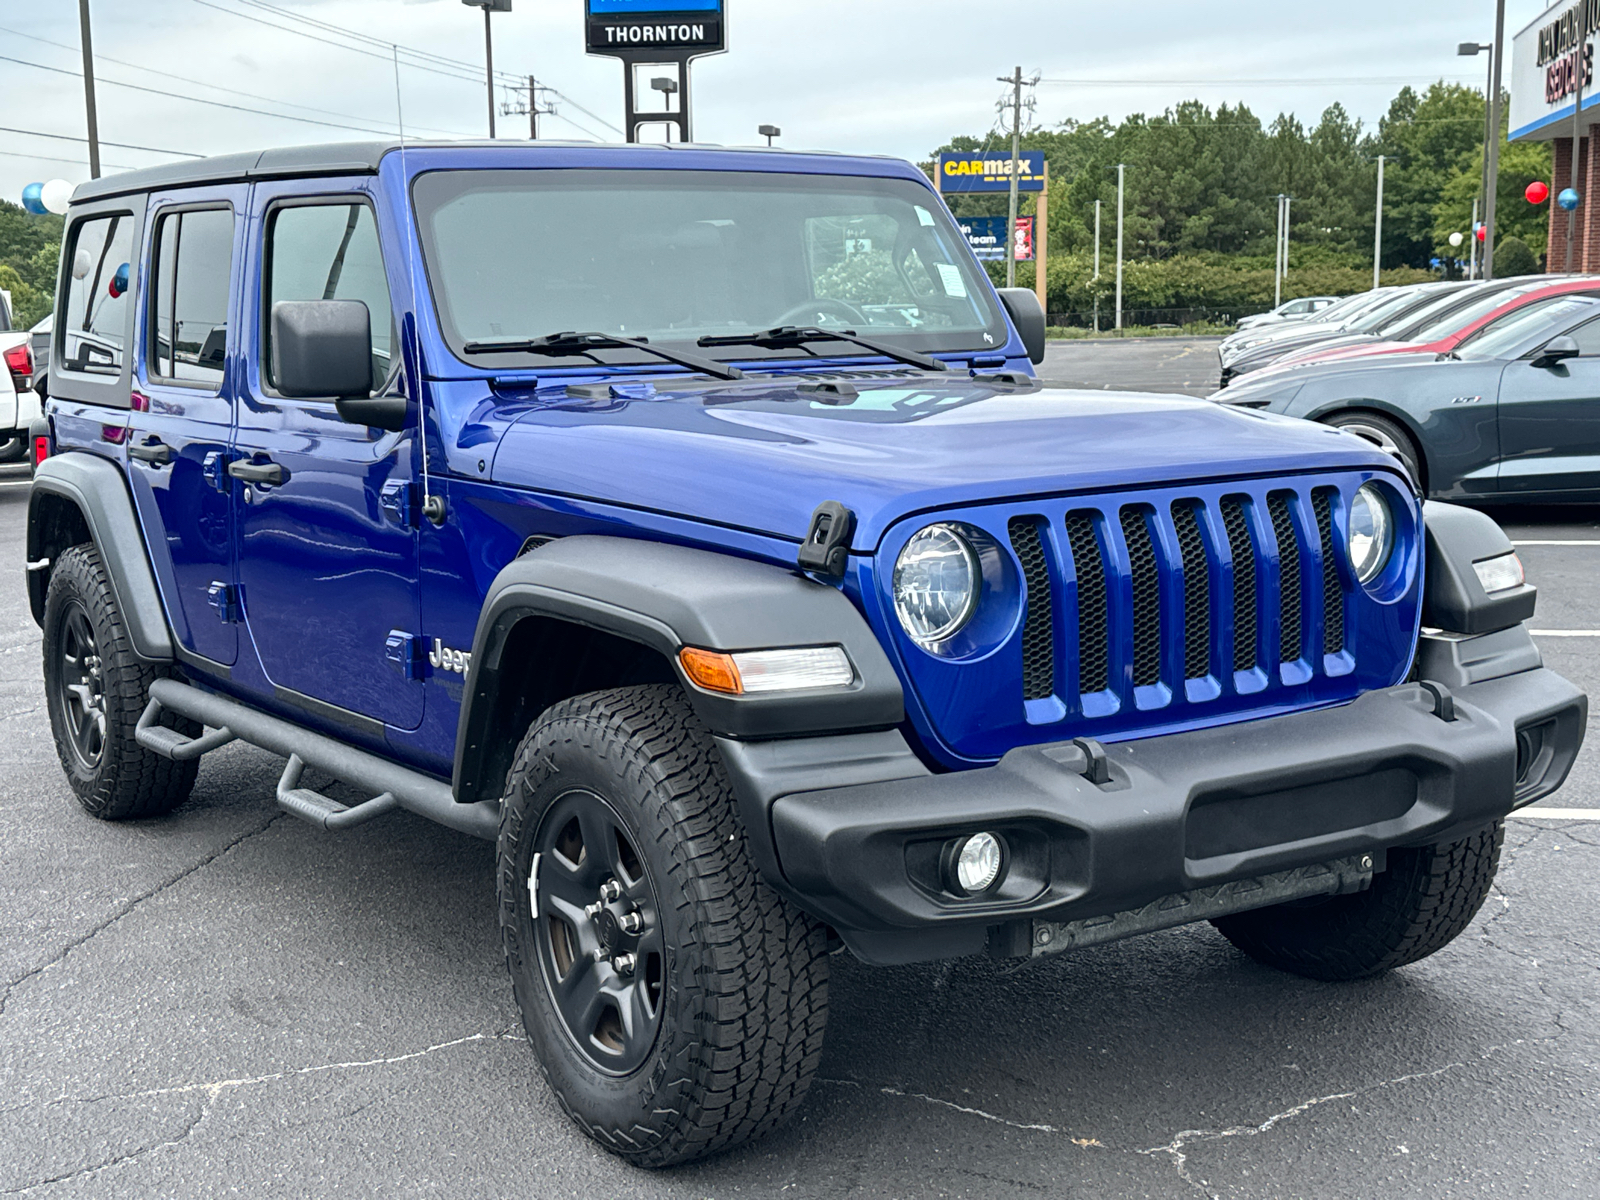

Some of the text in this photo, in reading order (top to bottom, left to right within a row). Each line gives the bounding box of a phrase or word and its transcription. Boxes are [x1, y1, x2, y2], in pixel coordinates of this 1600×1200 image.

[605, 24, 704, 43] THORNTON
[969, 235, 997, 245] team
[429, 638, 471, 681] Jeep
